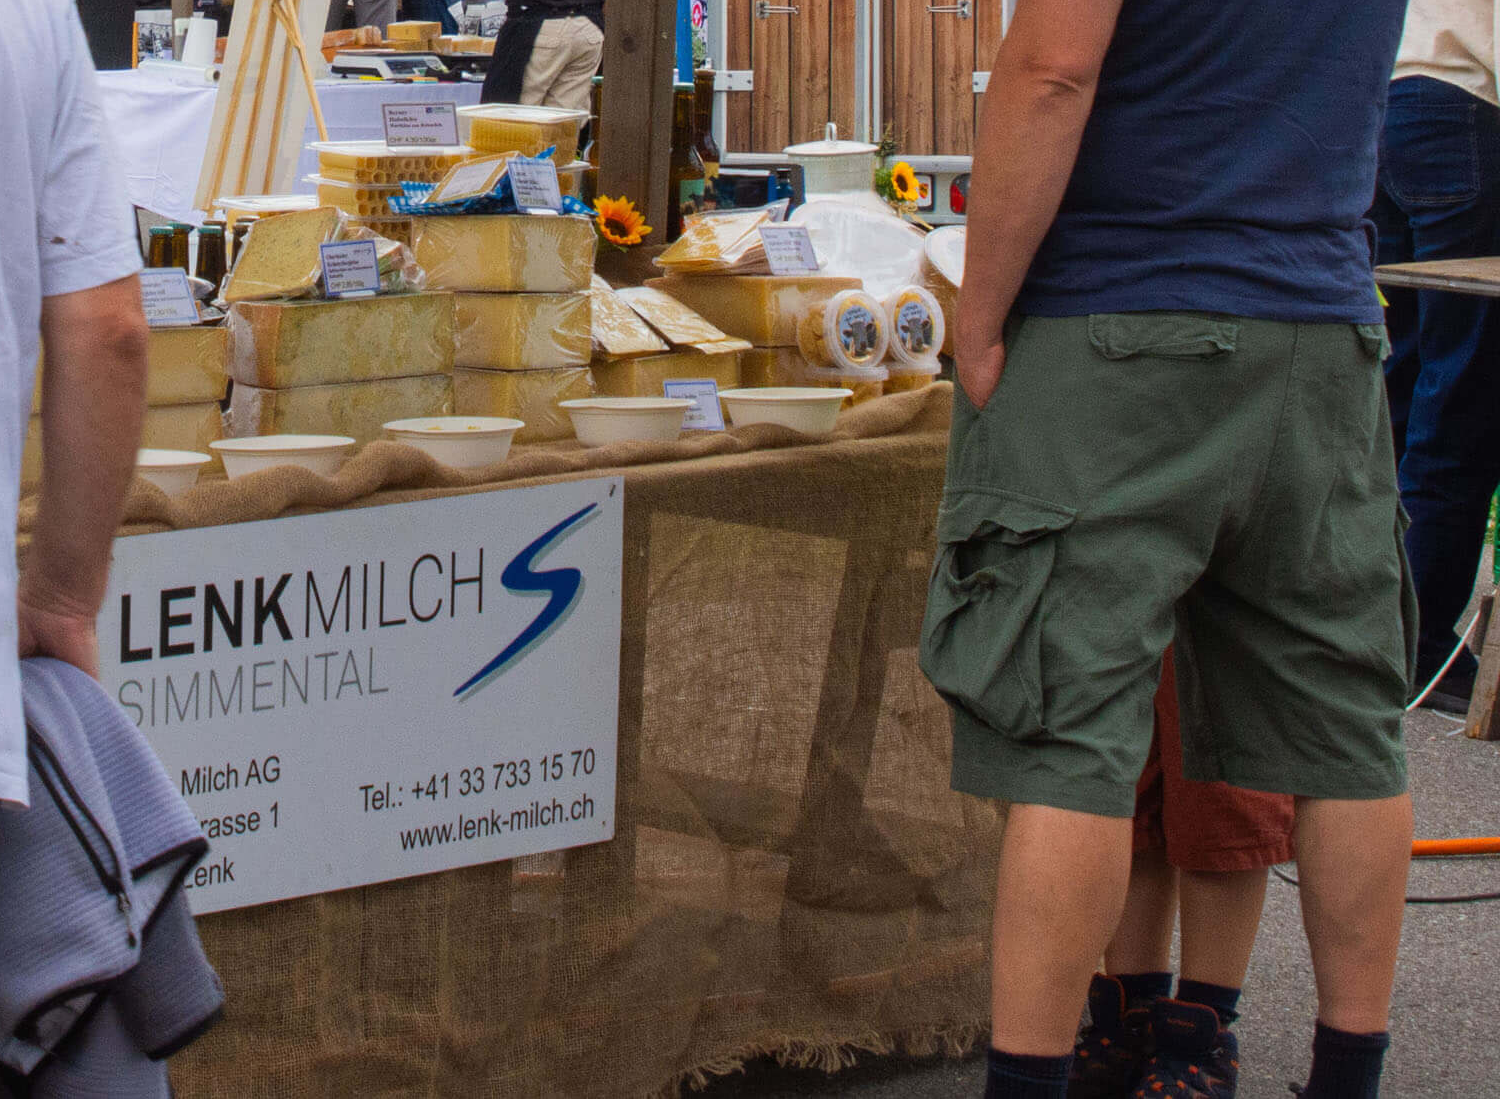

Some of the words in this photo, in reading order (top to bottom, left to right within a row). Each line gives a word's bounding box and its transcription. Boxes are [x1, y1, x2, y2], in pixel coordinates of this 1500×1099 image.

[120, 548, 483, 664] LENKMILCH
[118, 647, 389, 728] SIMMENTAL
[181, 759, 239, 796] Milch
[244, 755, 281, 787] AG
[359, 783, 403, 812] Tel.:
[412, 772, 449, 801] +41
[459, 767, 485, 796] 33
[493, 759, 531, 790] 733
[540, 753, 563, 782] 15
[571, 748, 595, 777] 70
[200, 809, 261, 839] rasse
[270, 802, 280, 829] 1
[400, 793, 594, 851] www.lenk-milch.ch
